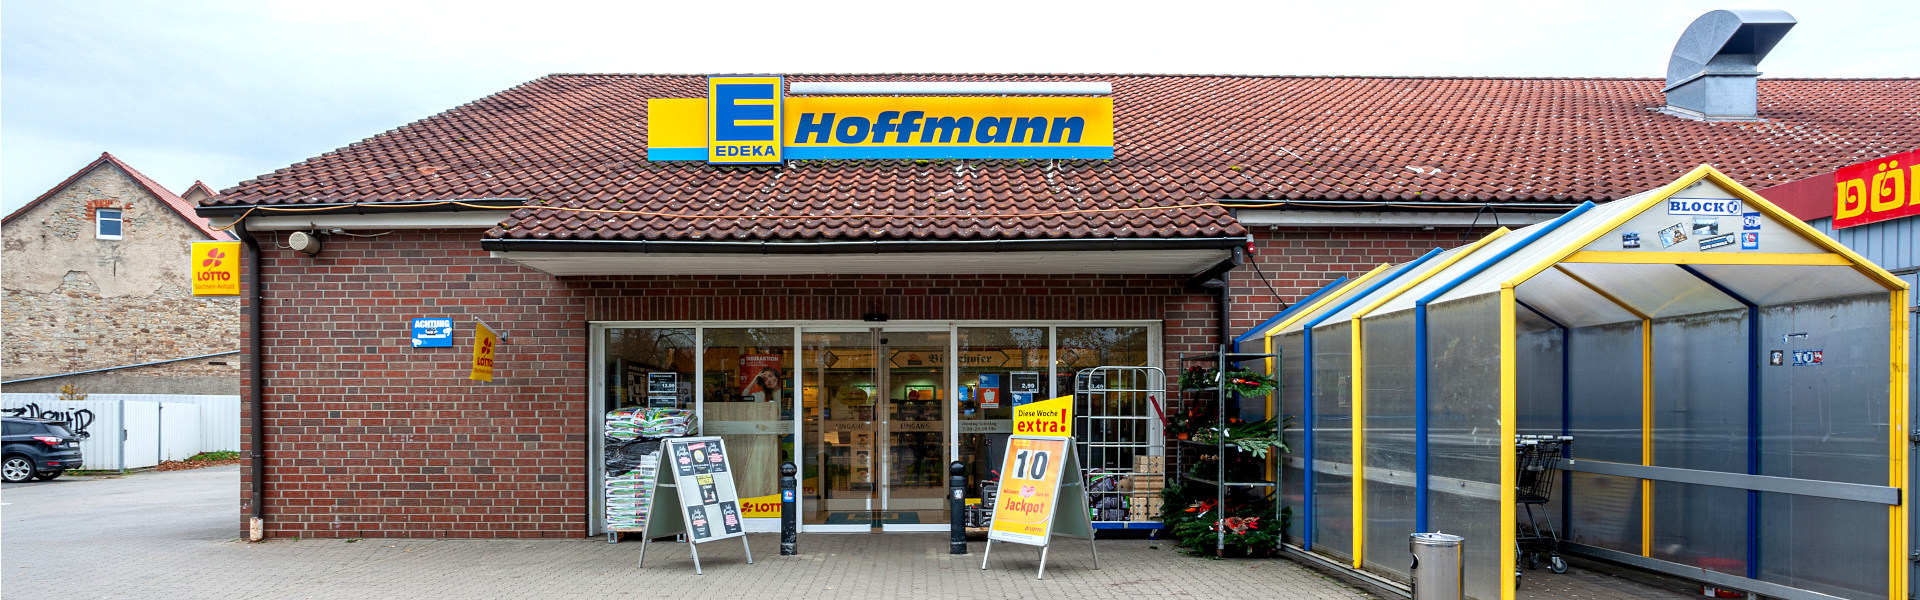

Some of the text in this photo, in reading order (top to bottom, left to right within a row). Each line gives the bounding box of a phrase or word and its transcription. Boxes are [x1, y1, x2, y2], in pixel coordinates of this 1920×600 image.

[716, 84, 774, 141] E
[794, 110, 1085, 144] Hoffmann
[716, 145, 775, 157] EDEKA
[1670, 201, 1724, 212] BLOCK
[198, 271, 230, 281] LOTTO
[414, 319, 450, 328] ACHTUNG
[1036, 409, 1058, 417] Woche
[1017, 408, 1066, 432] extra!
[1017, 450, 1048, 480] 10
[755, 503, 781, 512] LOTT
[1005, 497, 1044, 516] Jackpot
